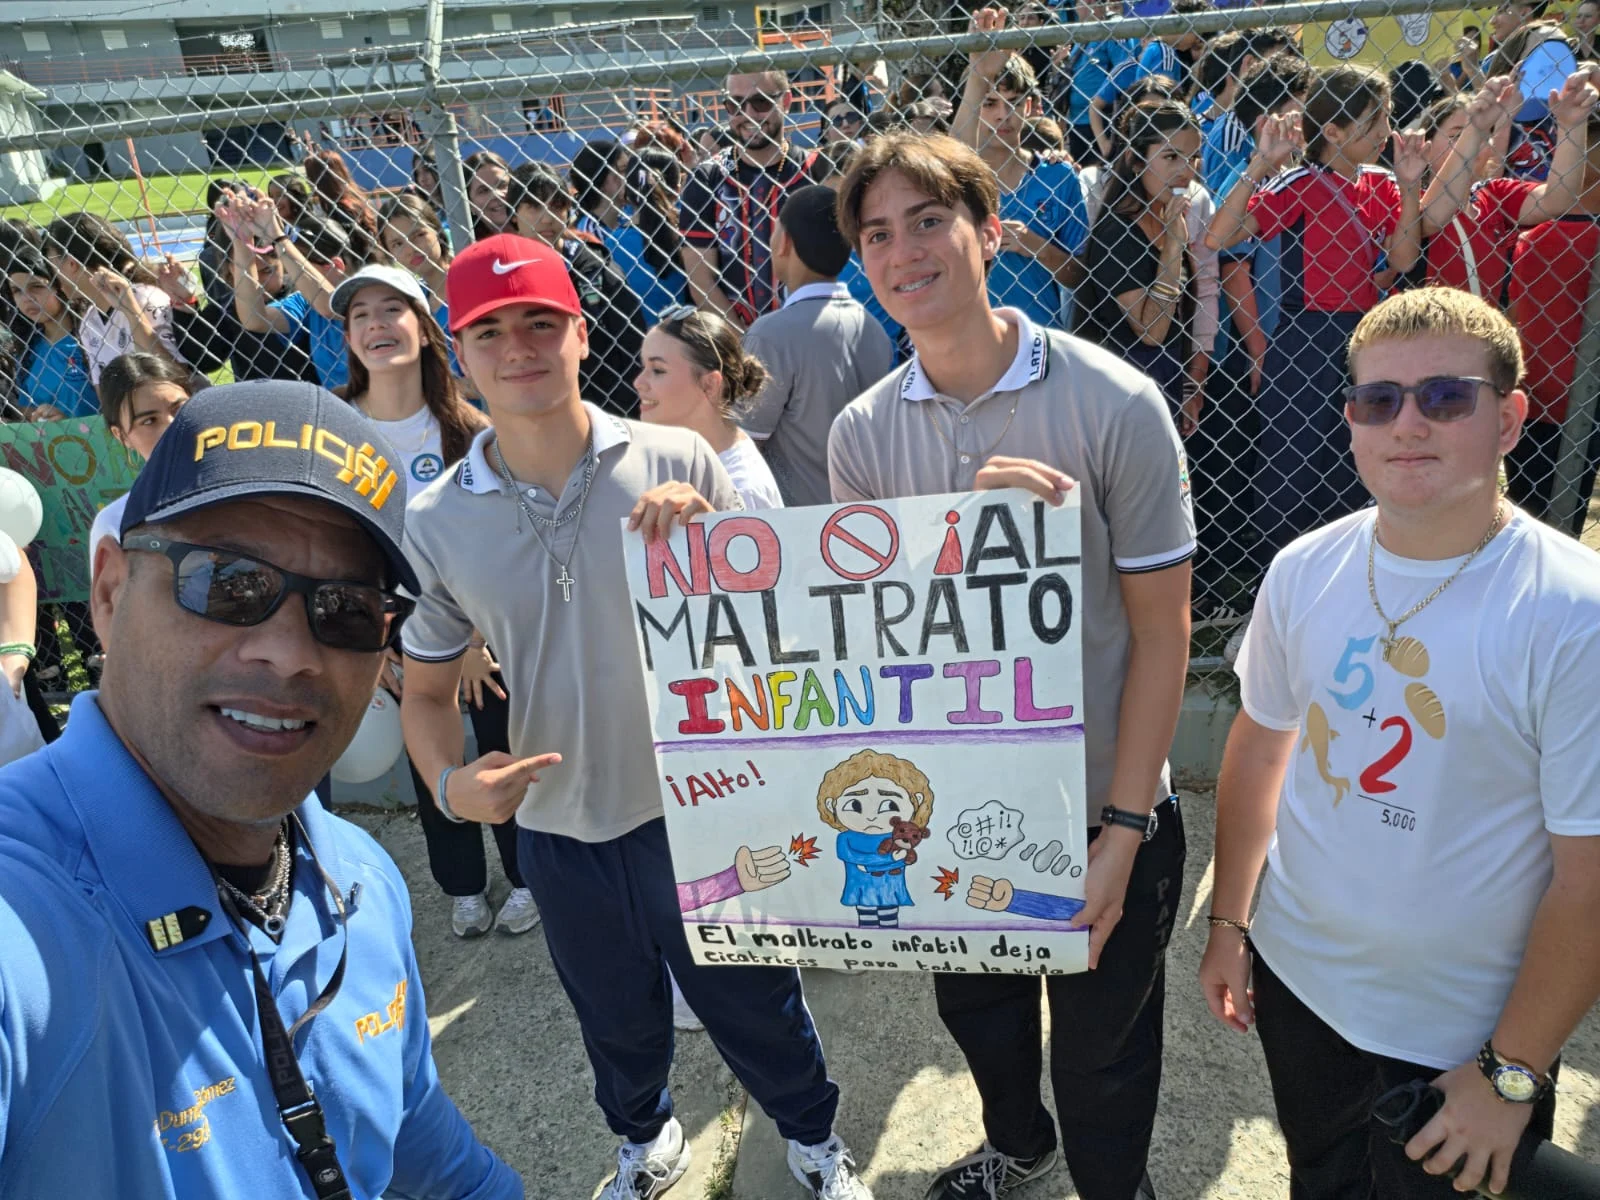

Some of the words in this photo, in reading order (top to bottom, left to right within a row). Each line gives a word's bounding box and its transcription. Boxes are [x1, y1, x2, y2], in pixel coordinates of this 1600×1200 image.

[194, 420, 396, 507] POLICIA
[644, 516, 782, 599] NO
[636, 571, 1074, 671] MALTRATO
[668, 656, 1074, 735] INFANTIL
[1325, 634, 1377, 711] 5
[665, 759, 766, 807] ¡Alto!
[1359, 716, 1413, 794] 2
[697, 924, 737, 946] El
[751, 927, 873, 950] maltrato
[892, 934, 968, 955] infatil
[990, 934, 1051, 962] deja
[843, 958, 898, 970] para
[916, 959, 967, 973] toda
[979, 961, 1001, 973] la
